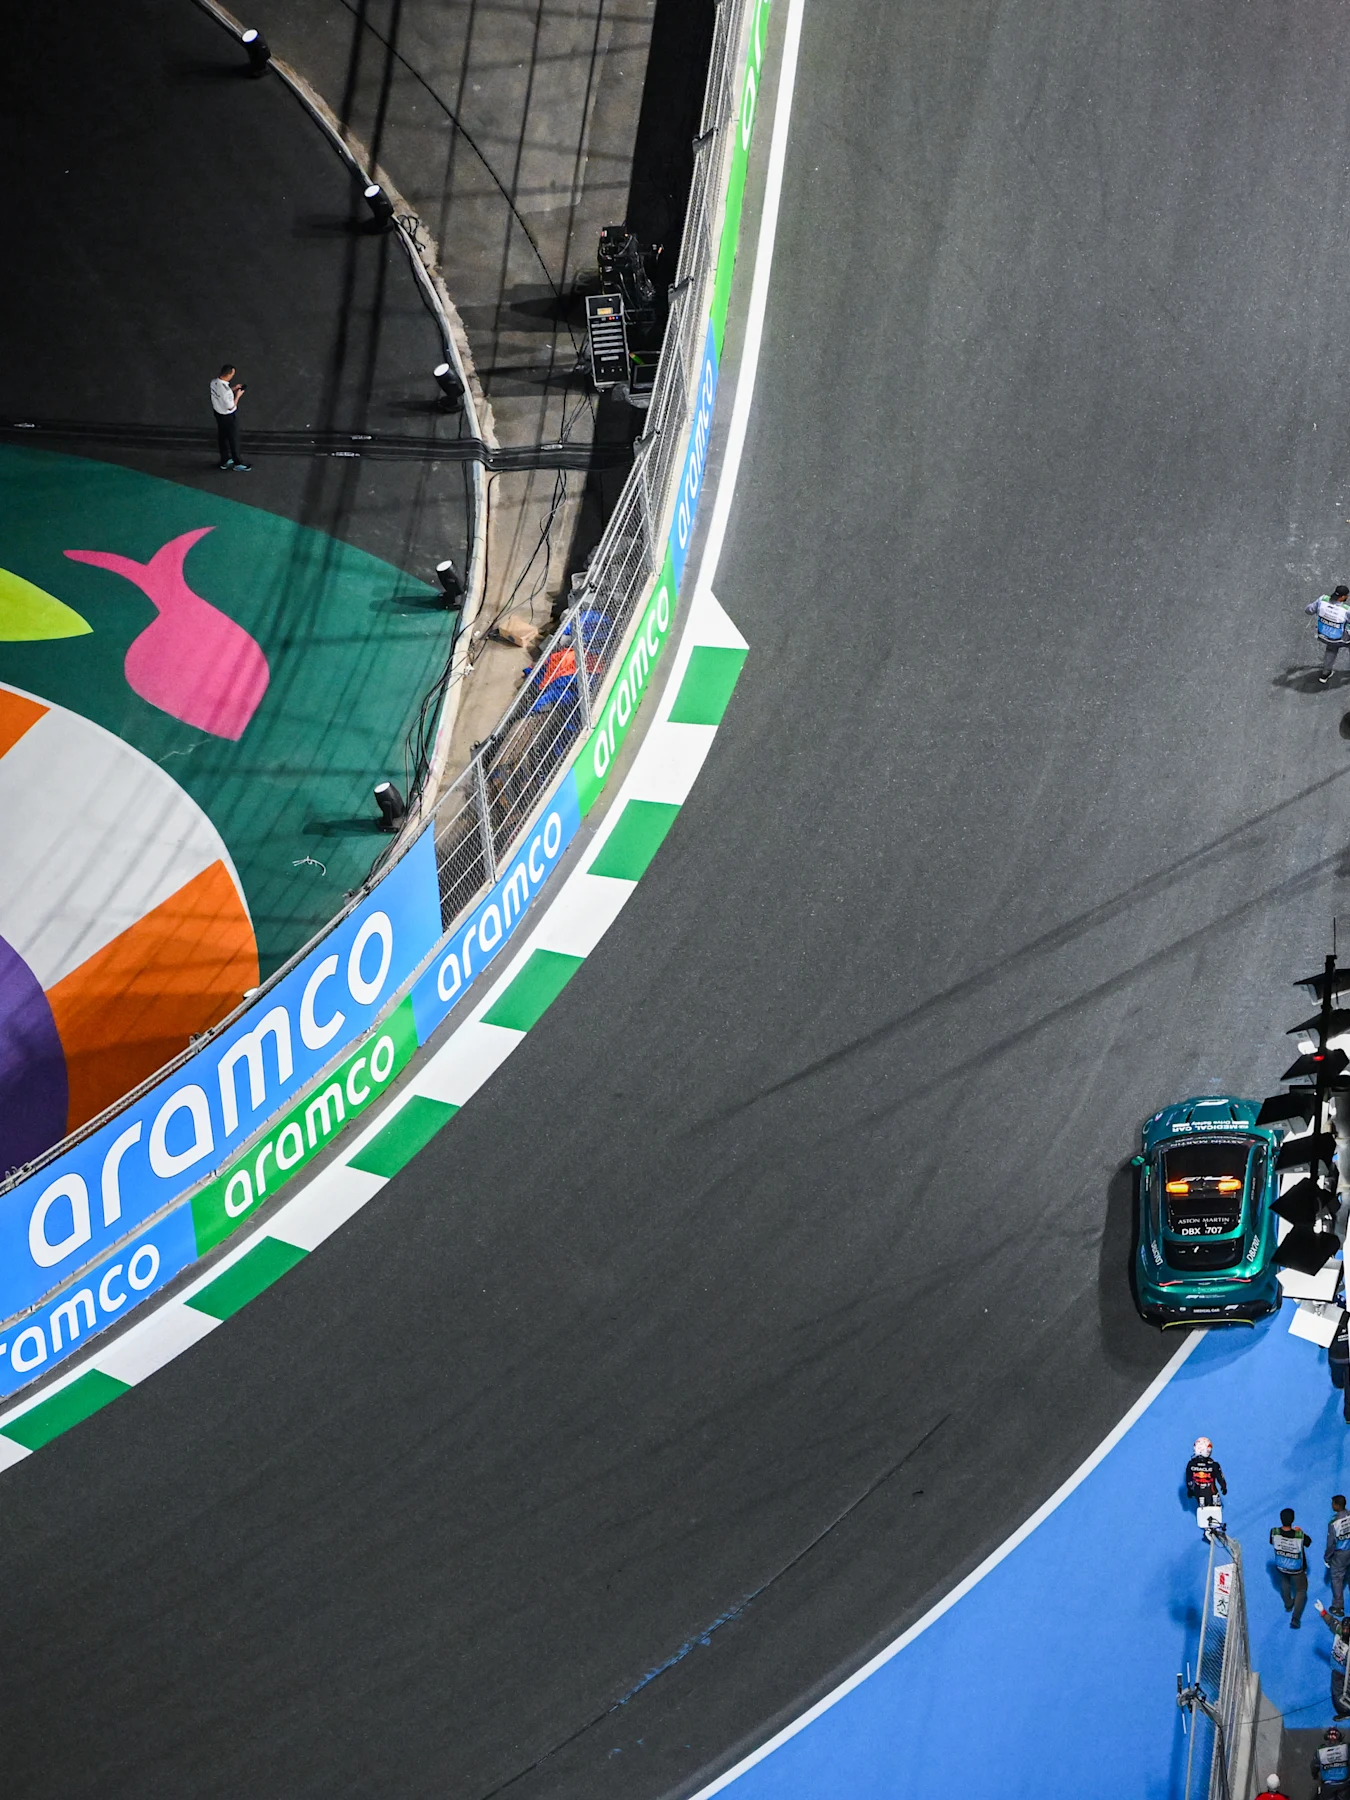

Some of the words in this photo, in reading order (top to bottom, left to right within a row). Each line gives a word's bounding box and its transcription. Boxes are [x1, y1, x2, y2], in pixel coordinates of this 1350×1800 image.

[742, 0, 767, 151] ar
[678, 359, 712, 550] aramco
[593, 585, 669, 779] aramco
[437, 811, 561, 1001] aramco
[28, 911, 393, 1268] aramco
[224, 1035, 395, 1218] aramco
[1181, 1227, 1201, 1236] DBX
[1206, 1226, 1223, 1234] 707
[1246, 1234, 1261, 1262] DBX707
